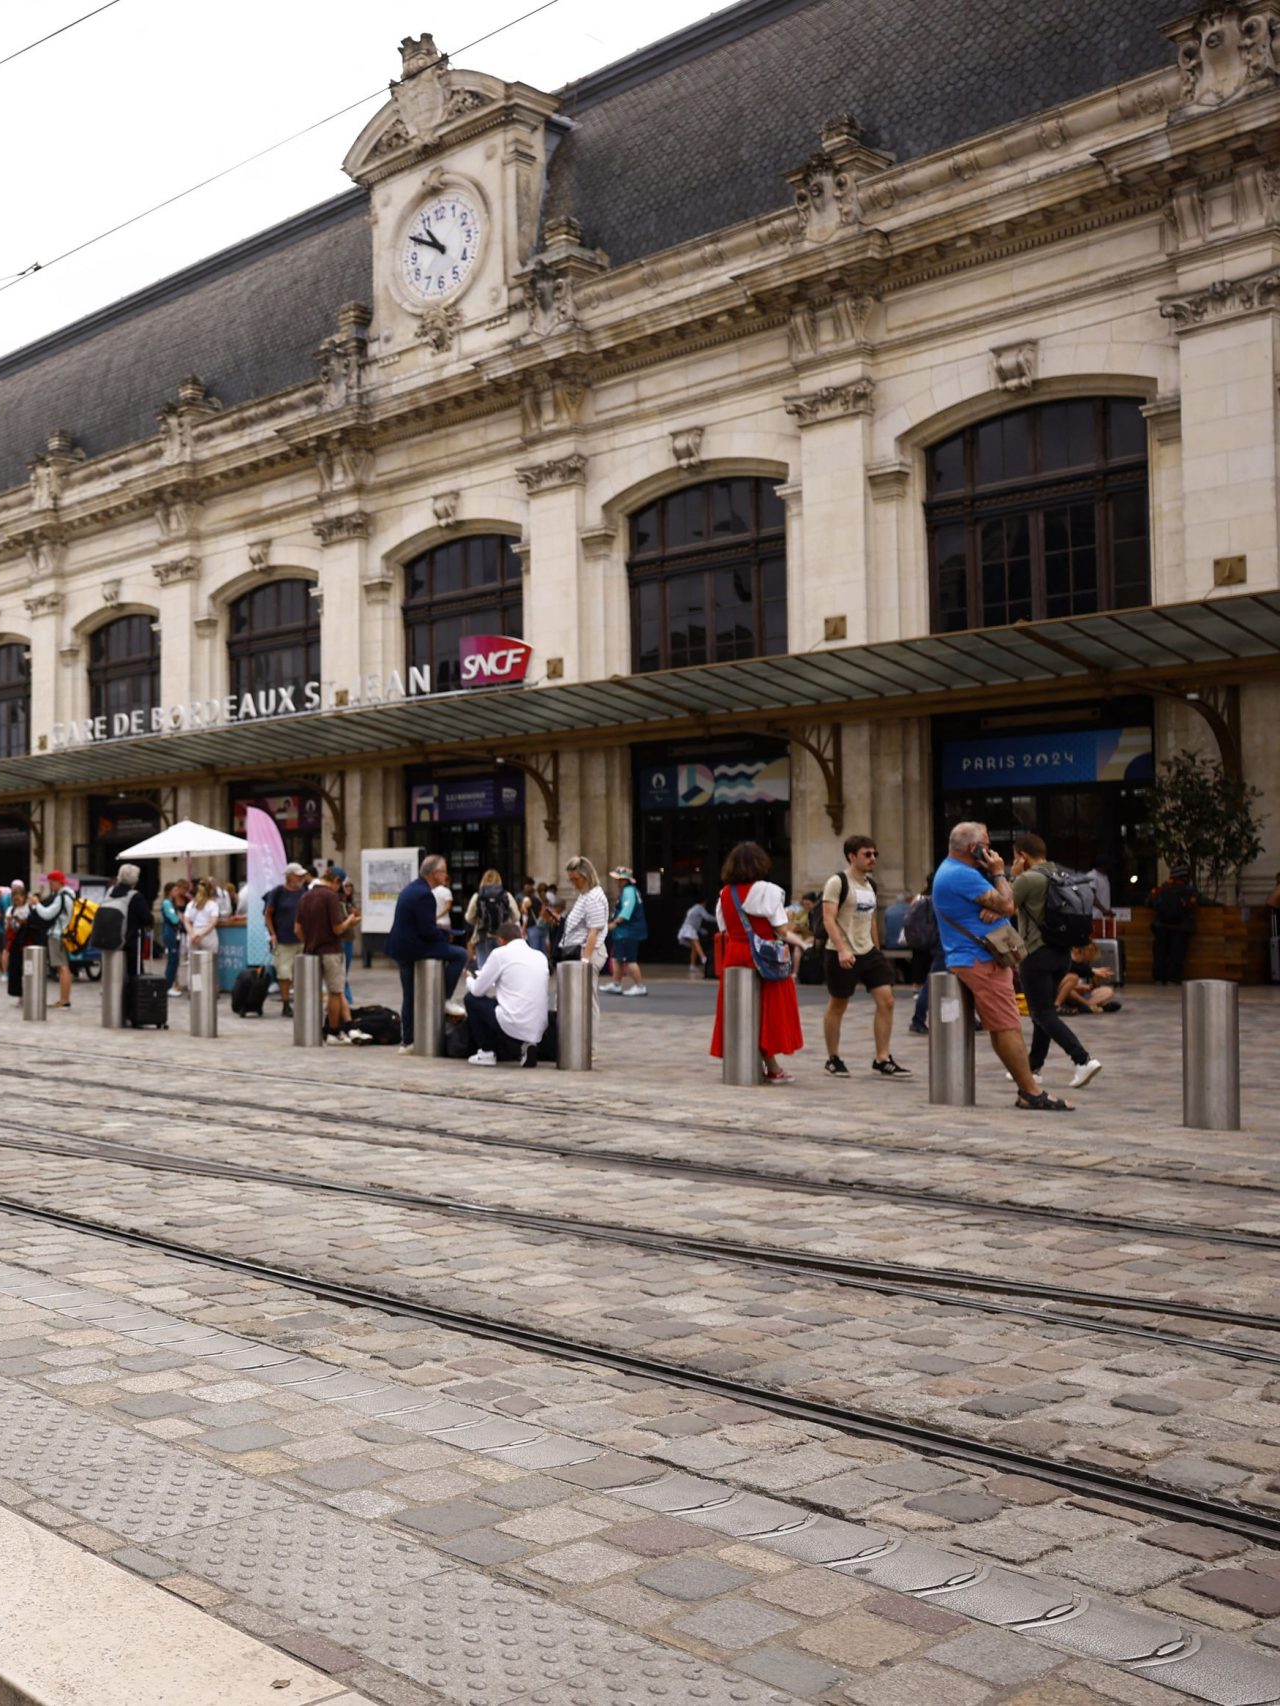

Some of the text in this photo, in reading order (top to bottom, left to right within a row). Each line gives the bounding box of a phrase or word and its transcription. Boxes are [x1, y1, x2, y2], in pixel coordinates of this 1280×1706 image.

[434, 206, 447, 221] 12
[451, 204, 457, 218] 1
[422, 216, 431, 229] 11
[460, 212, 469, 227] 2
[465, 229, 472, 243] 3
[411, 252, 418, 265] 9
[461, 247, 468, 261] 4
[414, 268, 422, 281] 8
[452, 266, 460, 280] 5
[424, 276, 432, 290] 7
[438, 275, 445, 289] 6
[461, 647, 526, 680] SNCF
[52, 715, 108, 750] GARE
[113, 709, 145, 737] DE
[151, 686, 296, 732] BORDEAUX
[962, 752, 1074, 772] PARIS 2024
